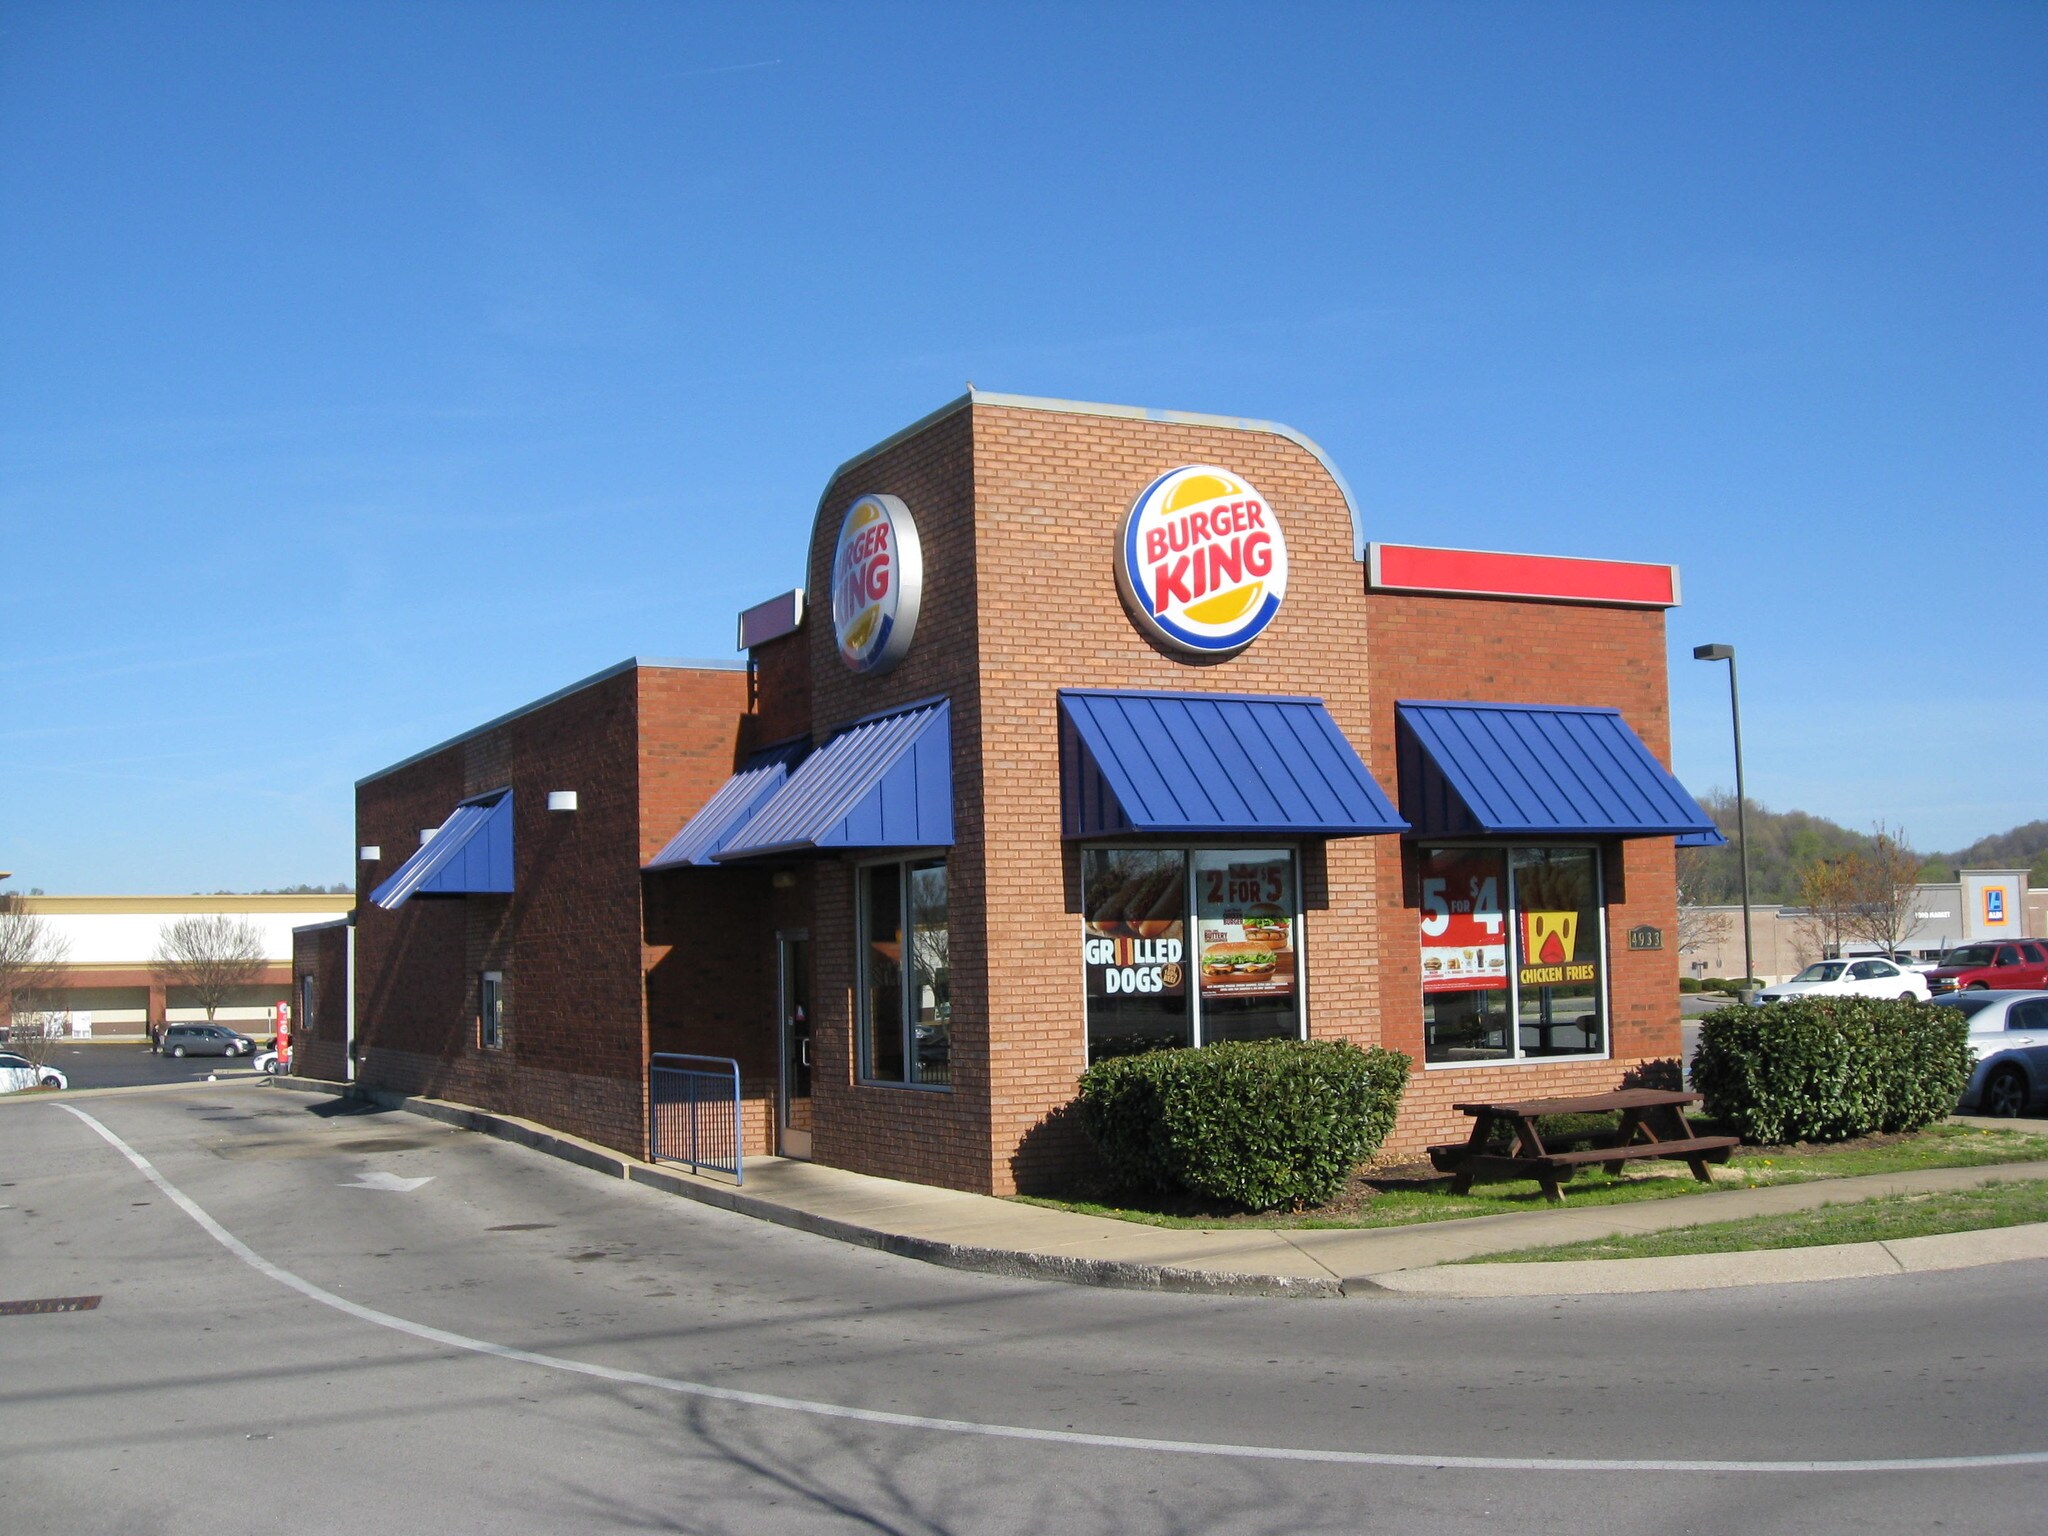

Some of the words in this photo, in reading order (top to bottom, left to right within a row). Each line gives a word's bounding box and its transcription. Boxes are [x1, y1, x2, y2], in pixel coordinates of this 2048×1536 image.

[837, 521, 890, 582] URGER
[1146, 500, 1266, 565] BURGER
[1154, 531, 1273, 615] KING
[1206, 870, 1225, 904] 2
[1229, 881, 1262, 903] FOR
[1261, 865, 1283, 902] $5
[1421, 878, 1450, 937] 5
[1451, 900, 1471, 914] FOR
[1469, 875, 1504, 935] $4
[1085, 937, 1183, 968] GRILLED
[1631, 932, 1660, 947] 4933
[1105, 965, 1163, 994] DOGS
[1520, 966, 1563, 985] CHICKEN
[1566, 964, 1595, 982] FRIES
